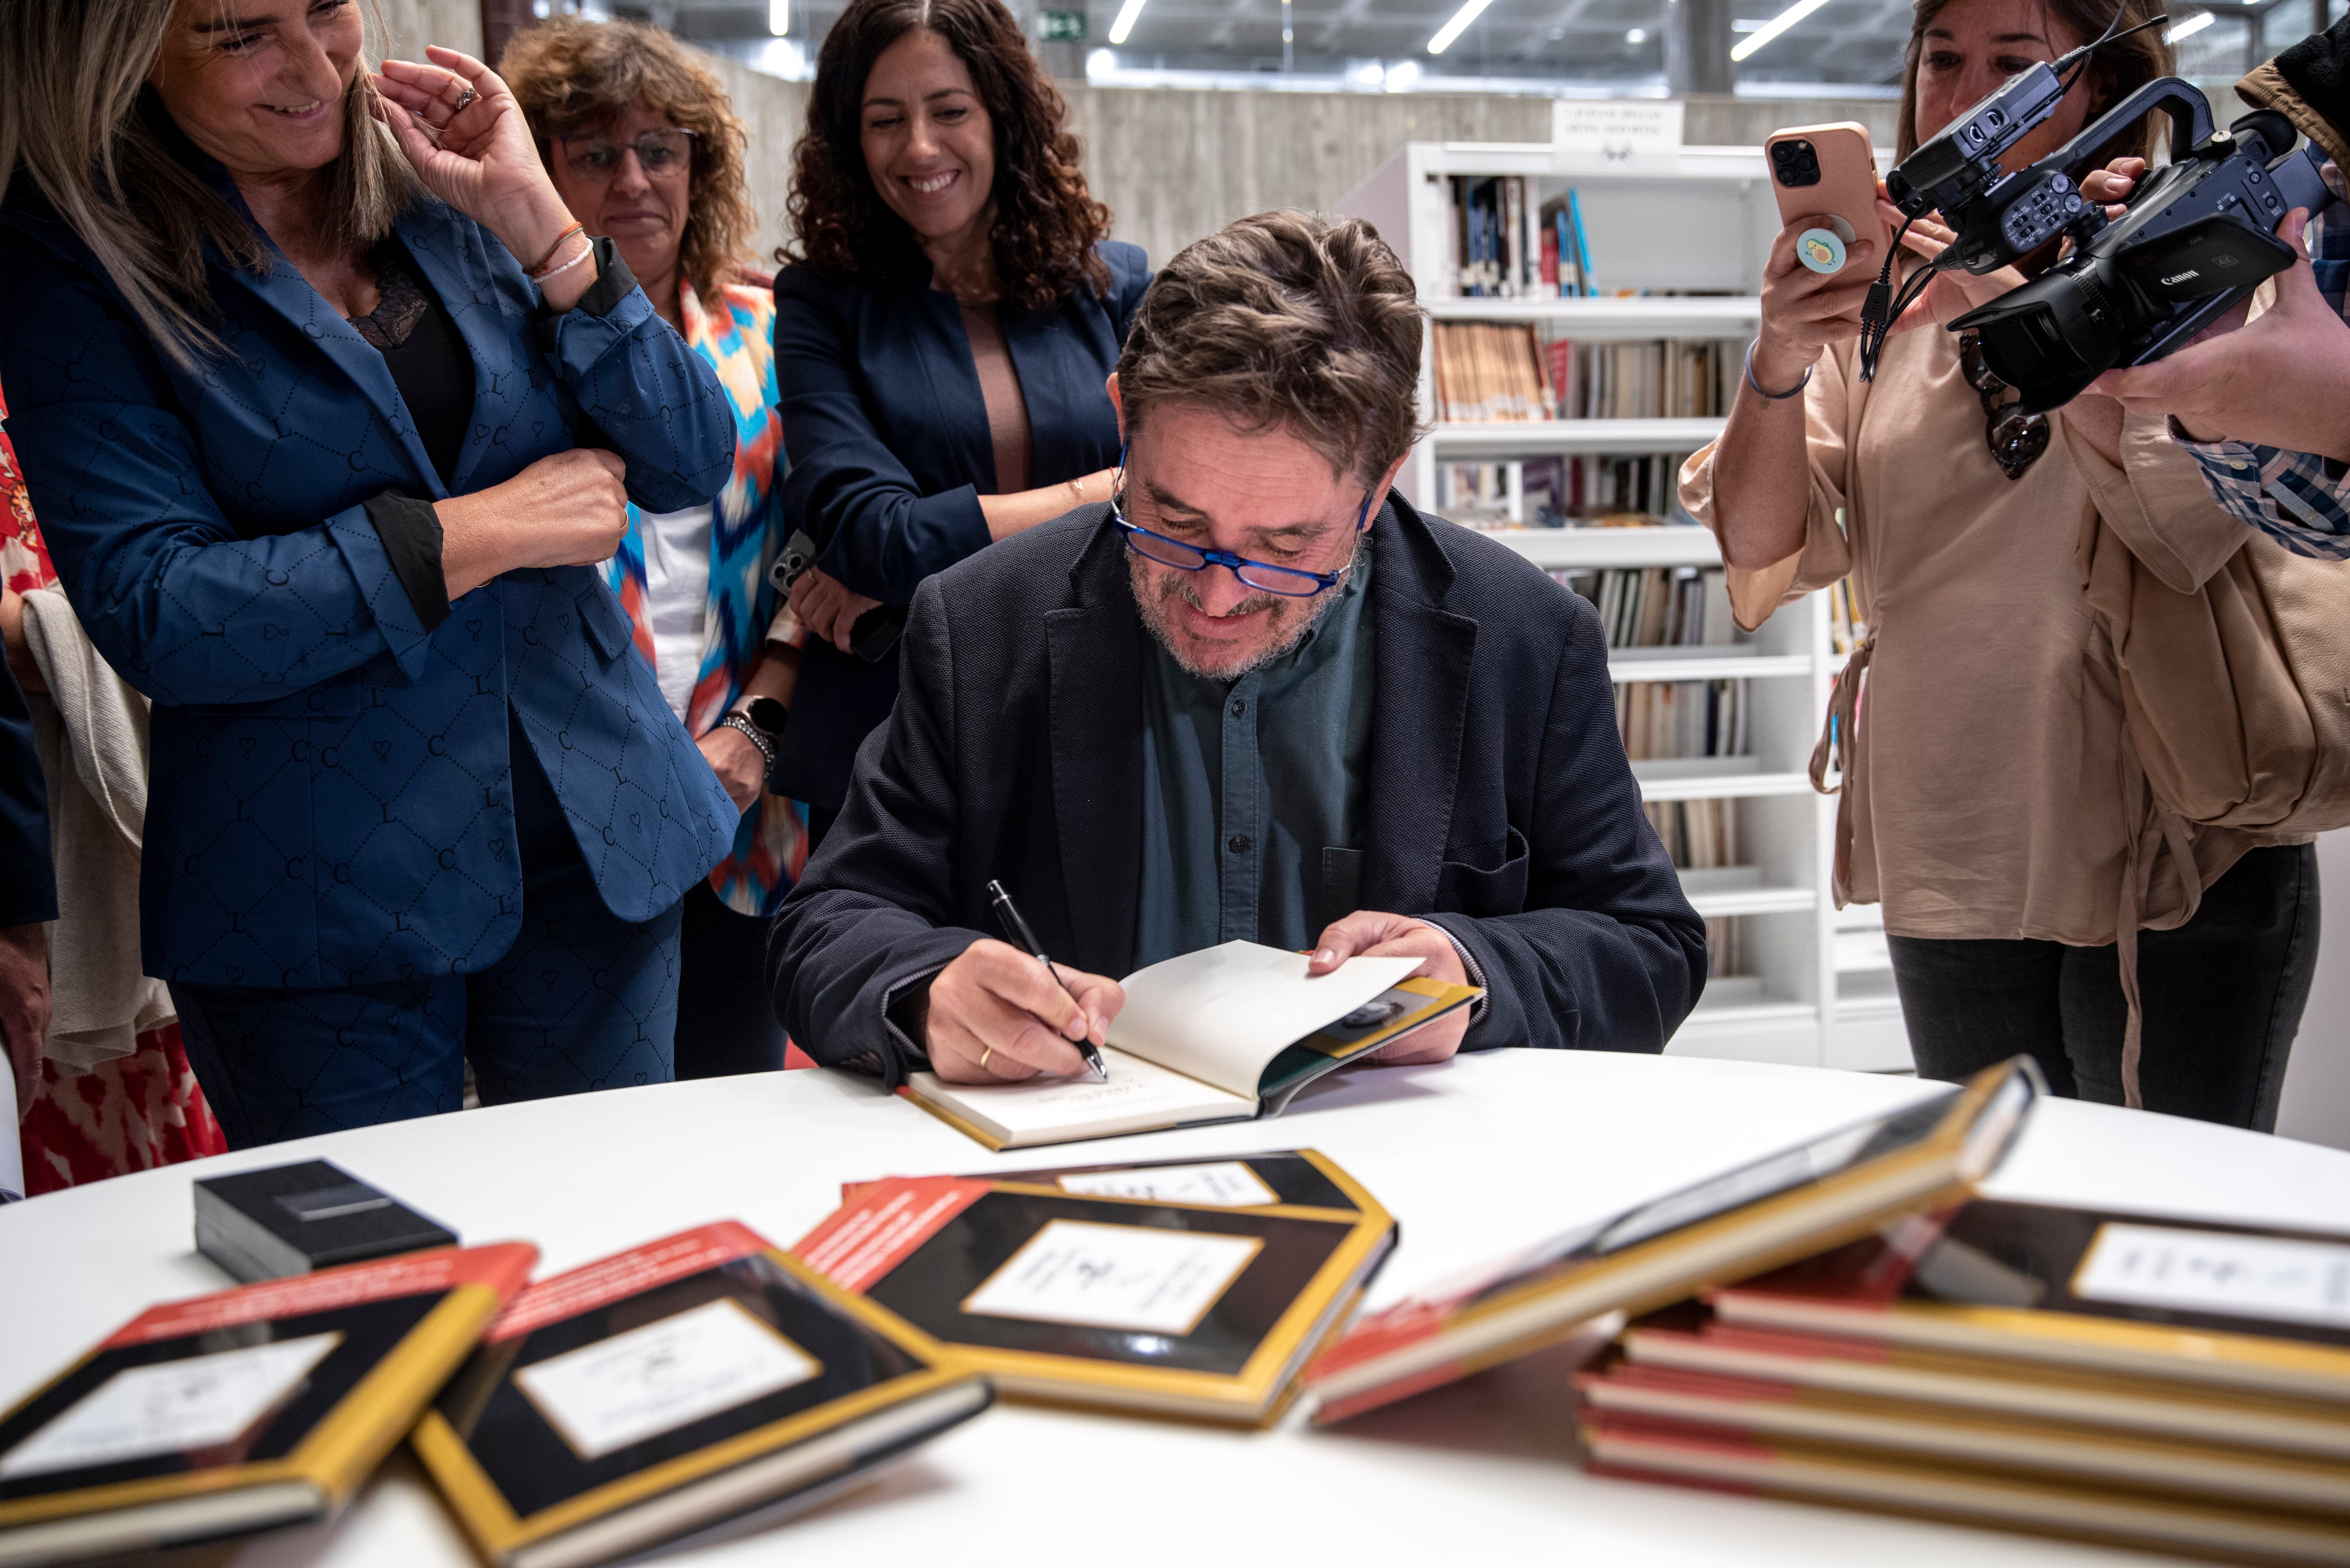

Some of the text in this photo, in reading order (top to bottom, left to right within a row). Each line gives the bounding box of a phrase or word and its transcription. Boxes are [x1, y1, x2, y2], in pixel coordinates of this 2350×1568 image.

[2221, 193, 2231, 202] CARD
[2273, 209, 2282, 217] INFO
[413, 235, 430, 250] C
[1962, 241, 1984, 255] Canon
[2161, 269, 2201, 285] Canon
[472, 291, 488, 306] L
[302, 322, 325, 340] C
[64, 361, 86, 383] C
[526, 369, 539, 388] L
[491, 373, 502, 396] L
[98, 420, 119, 441] C
[271, 417, 292, 439] L
[492, 426, 508, 445] C
[347, 450, 368, 472] C
[176, 475, 195, 495] L
[246, 481, 265, 502] C
[67, 497, 86, 517] L
[265, 568, 290, 587] C
[200, 622, 226, 639] L
[325, 623, 347, 638] L
[522, 624, 540, 647] C
[473, 674, 491, 696] L
[579, 670, 593, 690] L
[306, 690, 325, 712] C
[370, 687, 386, 708] L
[625, 705, 637, 724] C
[196, 737, 210, 757] C
[291, 740, 311, 762] C
[427, 733, 447, 757] C
[557, 730, 573, 751] C
[320, 746, 339, 769] C
[612, 766, 628, 787] L
[482, 787, 501, 809] L
[235, 800, 251, 823] L
[380, 802, 397, 824] L
[658, 798, 670, 820] C
[602, 825, 616, 846] C
[184, 853, 202, 876] C
[285, 857, 304, 881] C
[437, 847, 456, 871] C
[331, 862, 352, 885] C
[648, 867, 660, 888] L
[497, 894, 514, 916] L
[232, 911, 247, 933] L
[394, 910, 410, 932] L
[283, 967, 300, 988] C
[497, 969, 513, 991] C
[591, 968, 609, 989] C
[422, 995, 435, 1017] C
[336, 1026, 355, 1048] C
[541, 1029, 556, 1049] L
[636, 1022, 647, 1042] L
[242, 1034, 256, 1056] C
[396, 1065, 411, 1086] L
